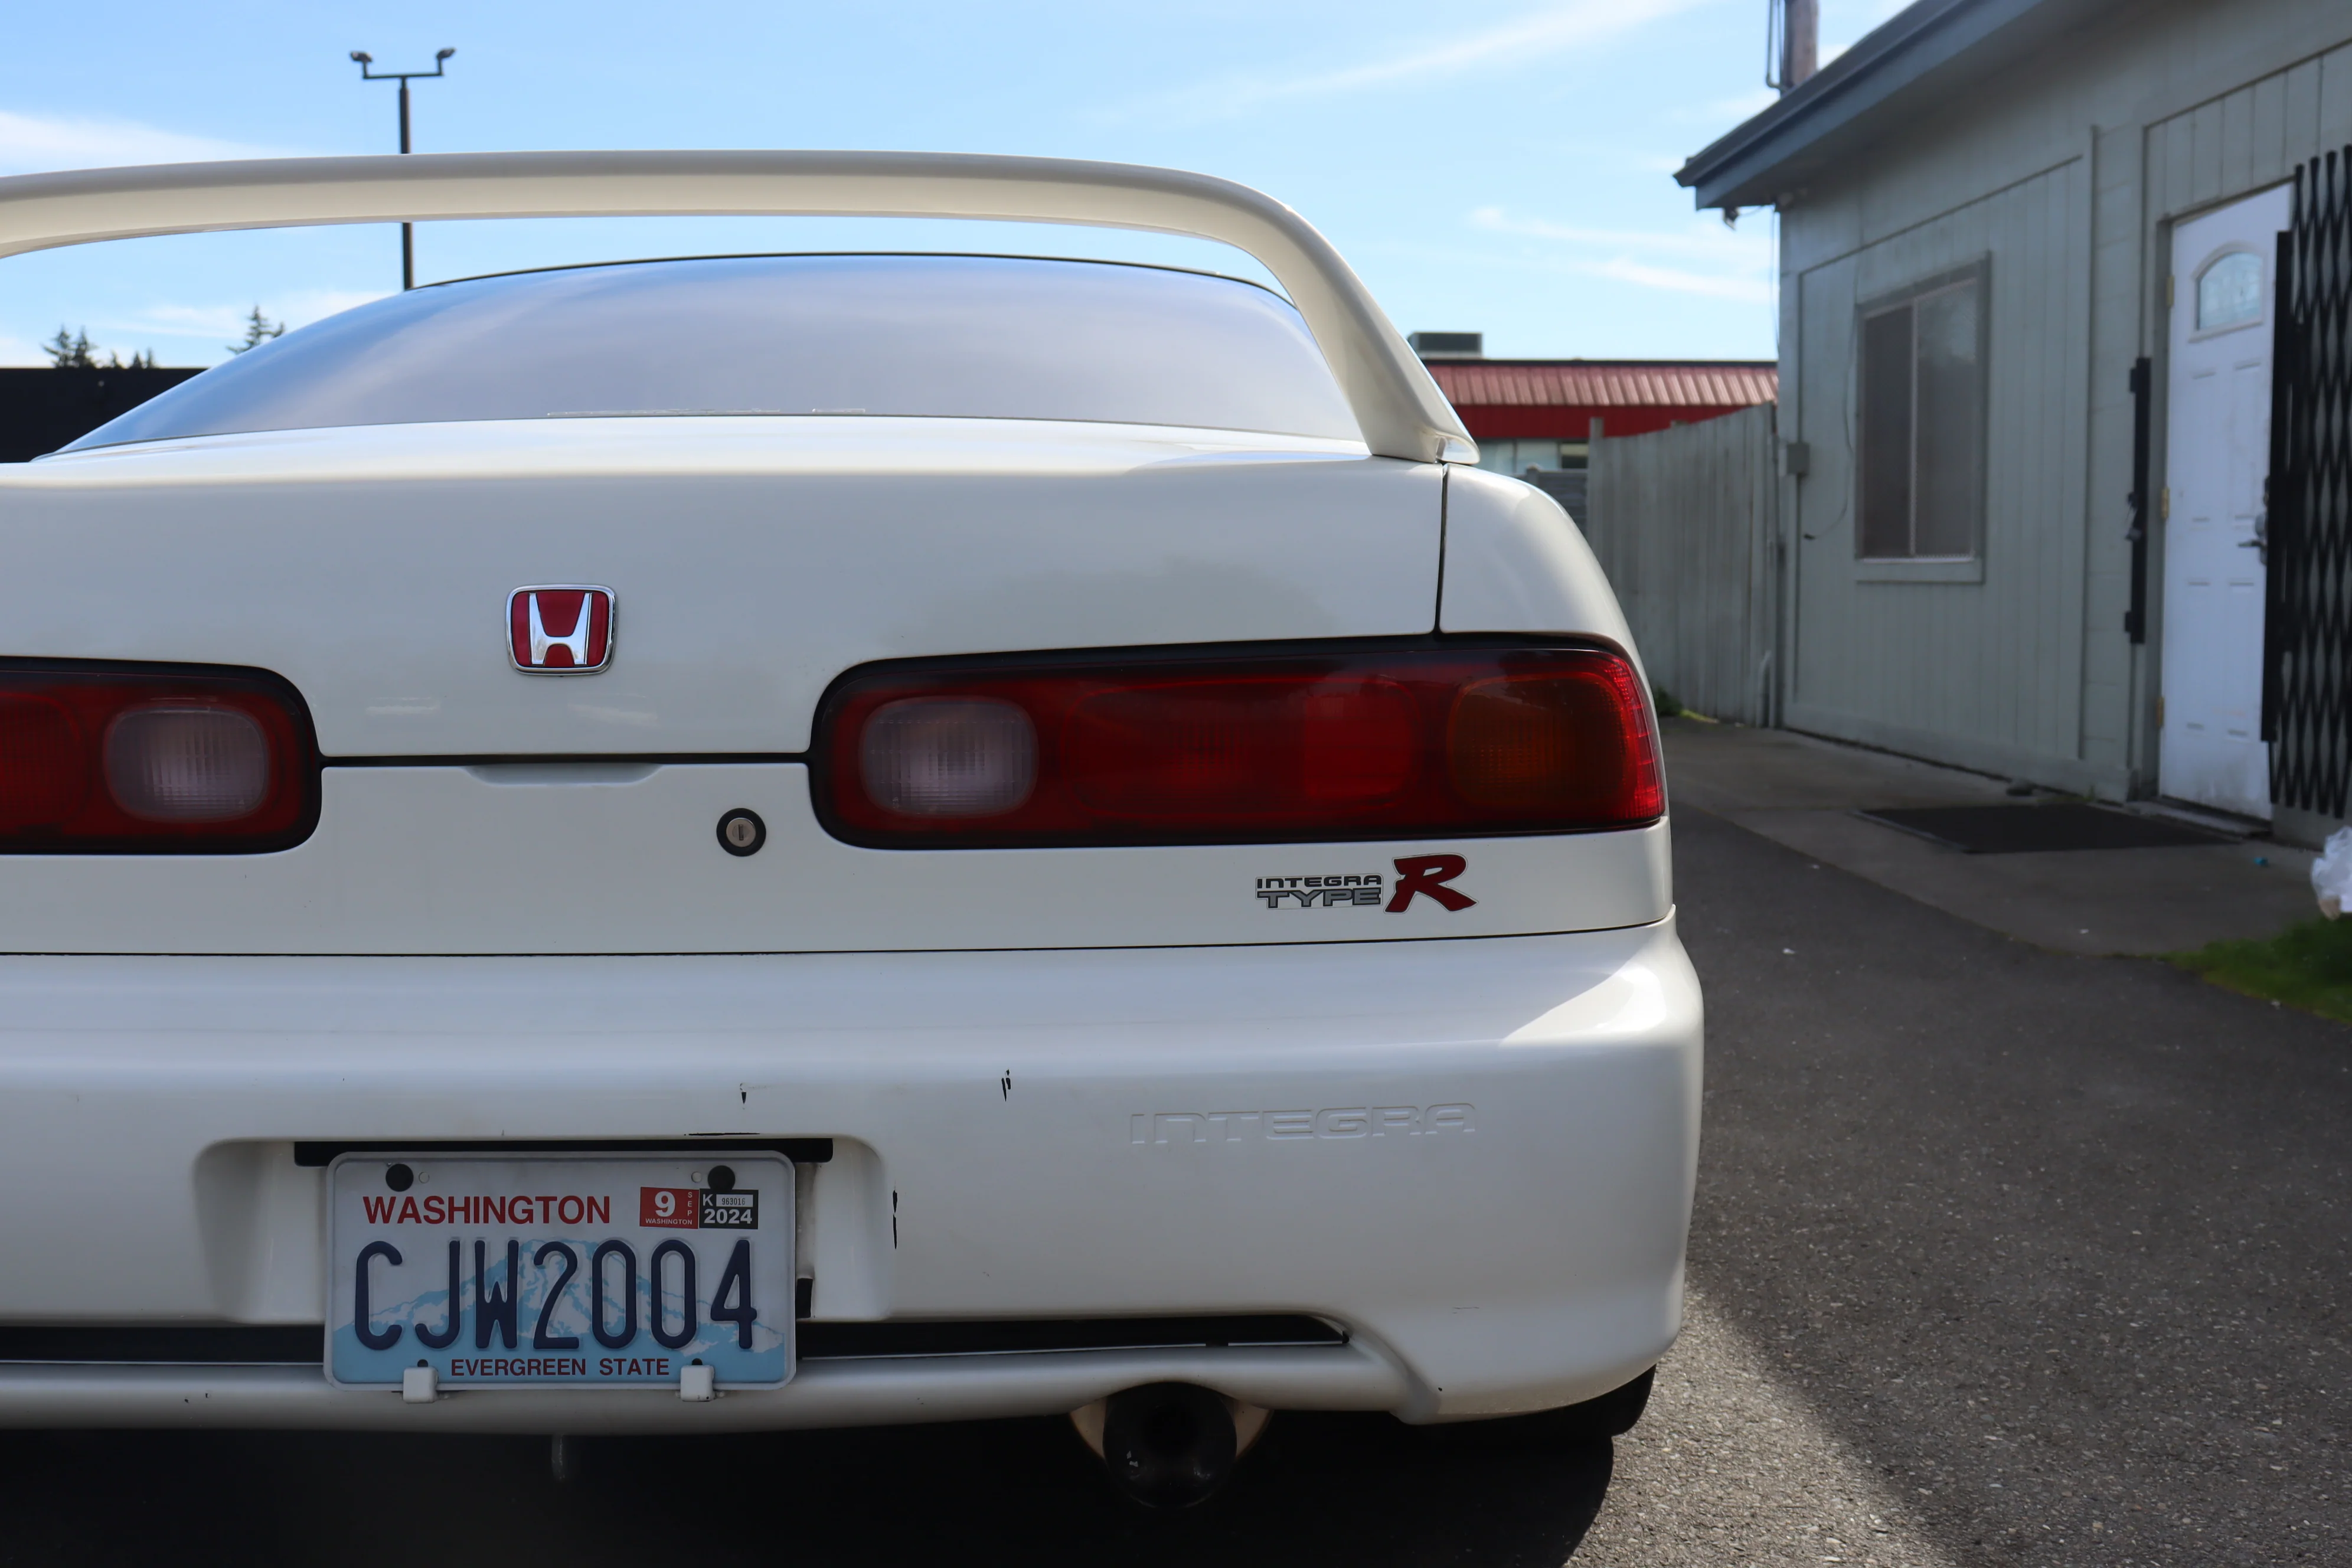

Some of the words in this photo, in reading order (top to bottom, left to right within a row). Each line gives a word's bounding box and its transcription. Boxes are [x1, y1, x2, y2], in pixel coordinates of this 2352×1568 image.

[1257, 876, 1382, 888] INTEGRA
[1257, 887, 1381, 909] TYPE
[1384, 854, 1478, 913] R
[1131, 1103, 1475, 1144] INTEGRA
[362, 1195, 610, 1224] WASHINGTON
[654, 1191, 676, 1217] 9
[703, 1194, 713, 1206] K
[704, 1208, 753, 1224] 2024
[355, 1239, 758, 1350] CJW2004
[451, 1358, 586, 1377] EVERGREEN
[599, 1358, 669, 1376] STATE
